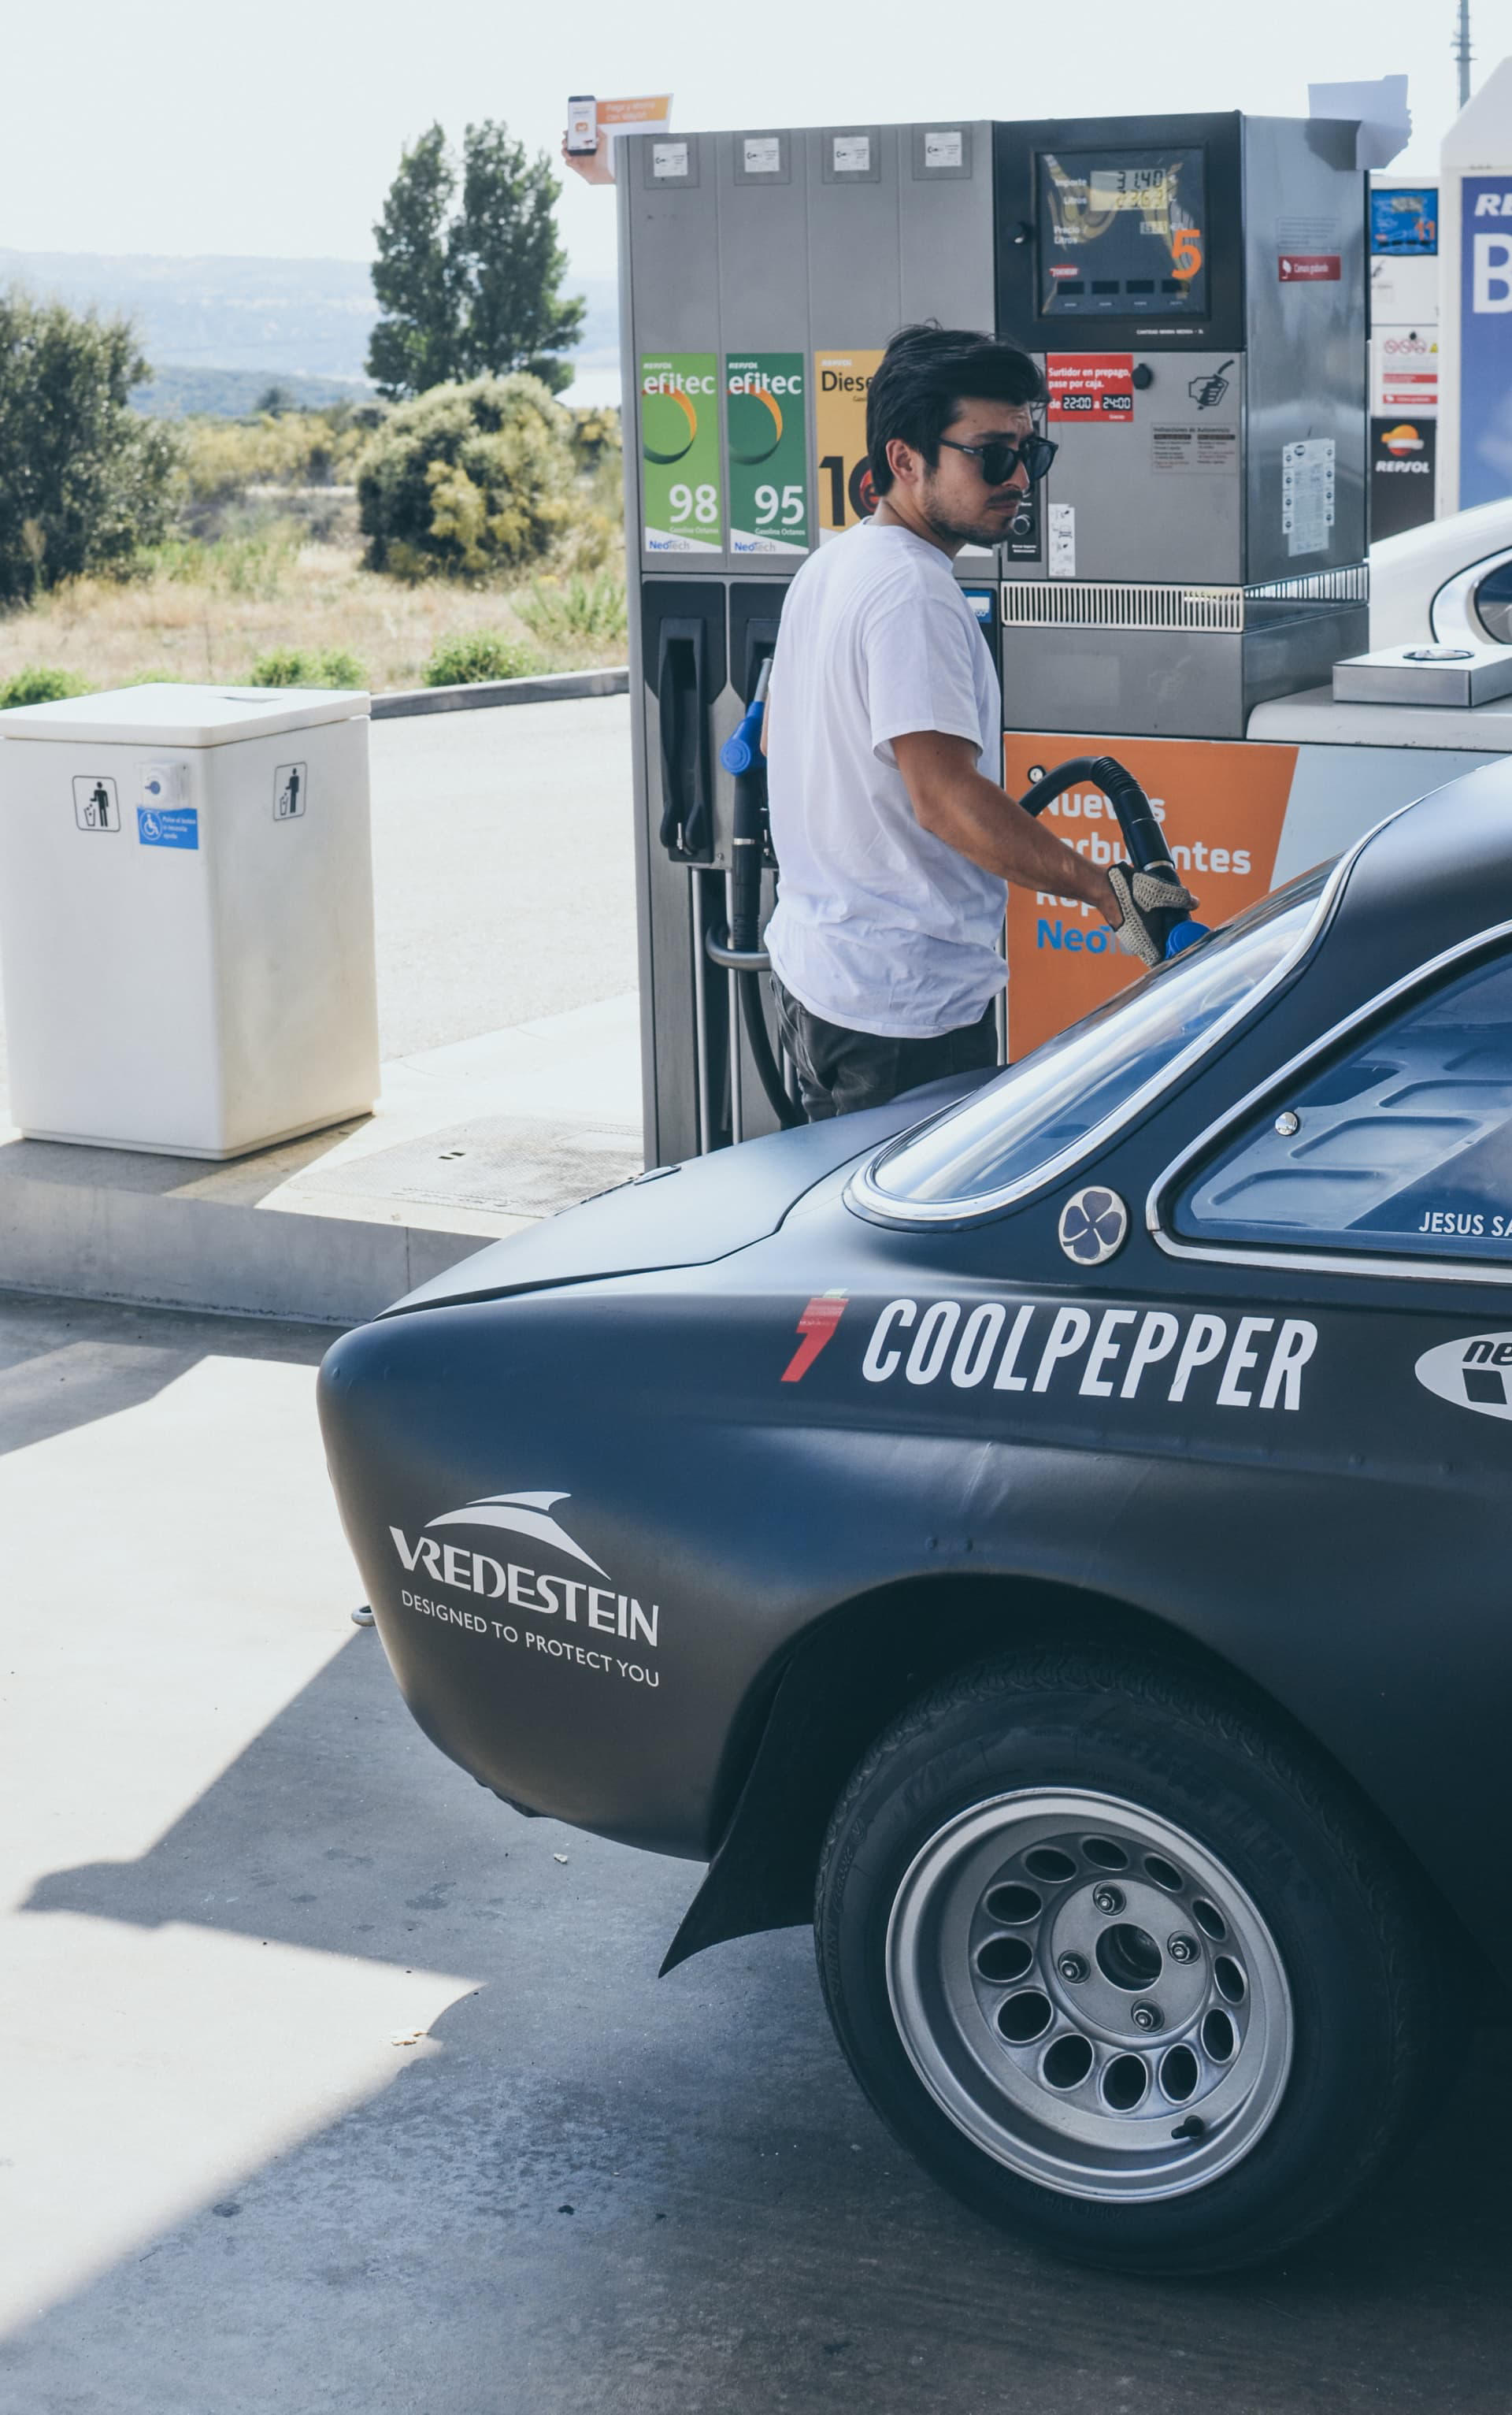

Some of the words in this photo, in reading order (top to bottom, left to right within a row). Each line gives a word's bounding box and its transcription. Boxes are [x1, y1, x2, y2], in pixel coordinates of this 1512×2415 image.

[1171, 229, 1203, 279] 5
[643, 373, 716, 395] efitec
[728, 373, 802, 395] efitec
[1047, 367, 1081, 377] Surtidor
[1047, 380, 1068, 391] pase
[1069, 380, 1084, 391] por
[1084, 380, 1105, 390] caja.
[1050, 399, 1061, 409] de
[1063, 397, 1091, 409] 22:00
[1102, 397, 1131, 409] 24:00
[1375, 460, 1430, 473] REPSOL
[669, 484, 718, 523] 98
[754, 484, 805, 525] 95
[1418, 1211, 1484, 1235] JESUS
[862, 1298, 1319, 1411] COOLPEPPER
[389, 1524, 659, 1648] VREDESTEIN
[402, 1589, 487, 1634] DESIGNED
[491, 1619, 518, 1643] TO
[525, 1630, 612, 1672] PROTECT
[617, 1657, 659, 1687] YOU
